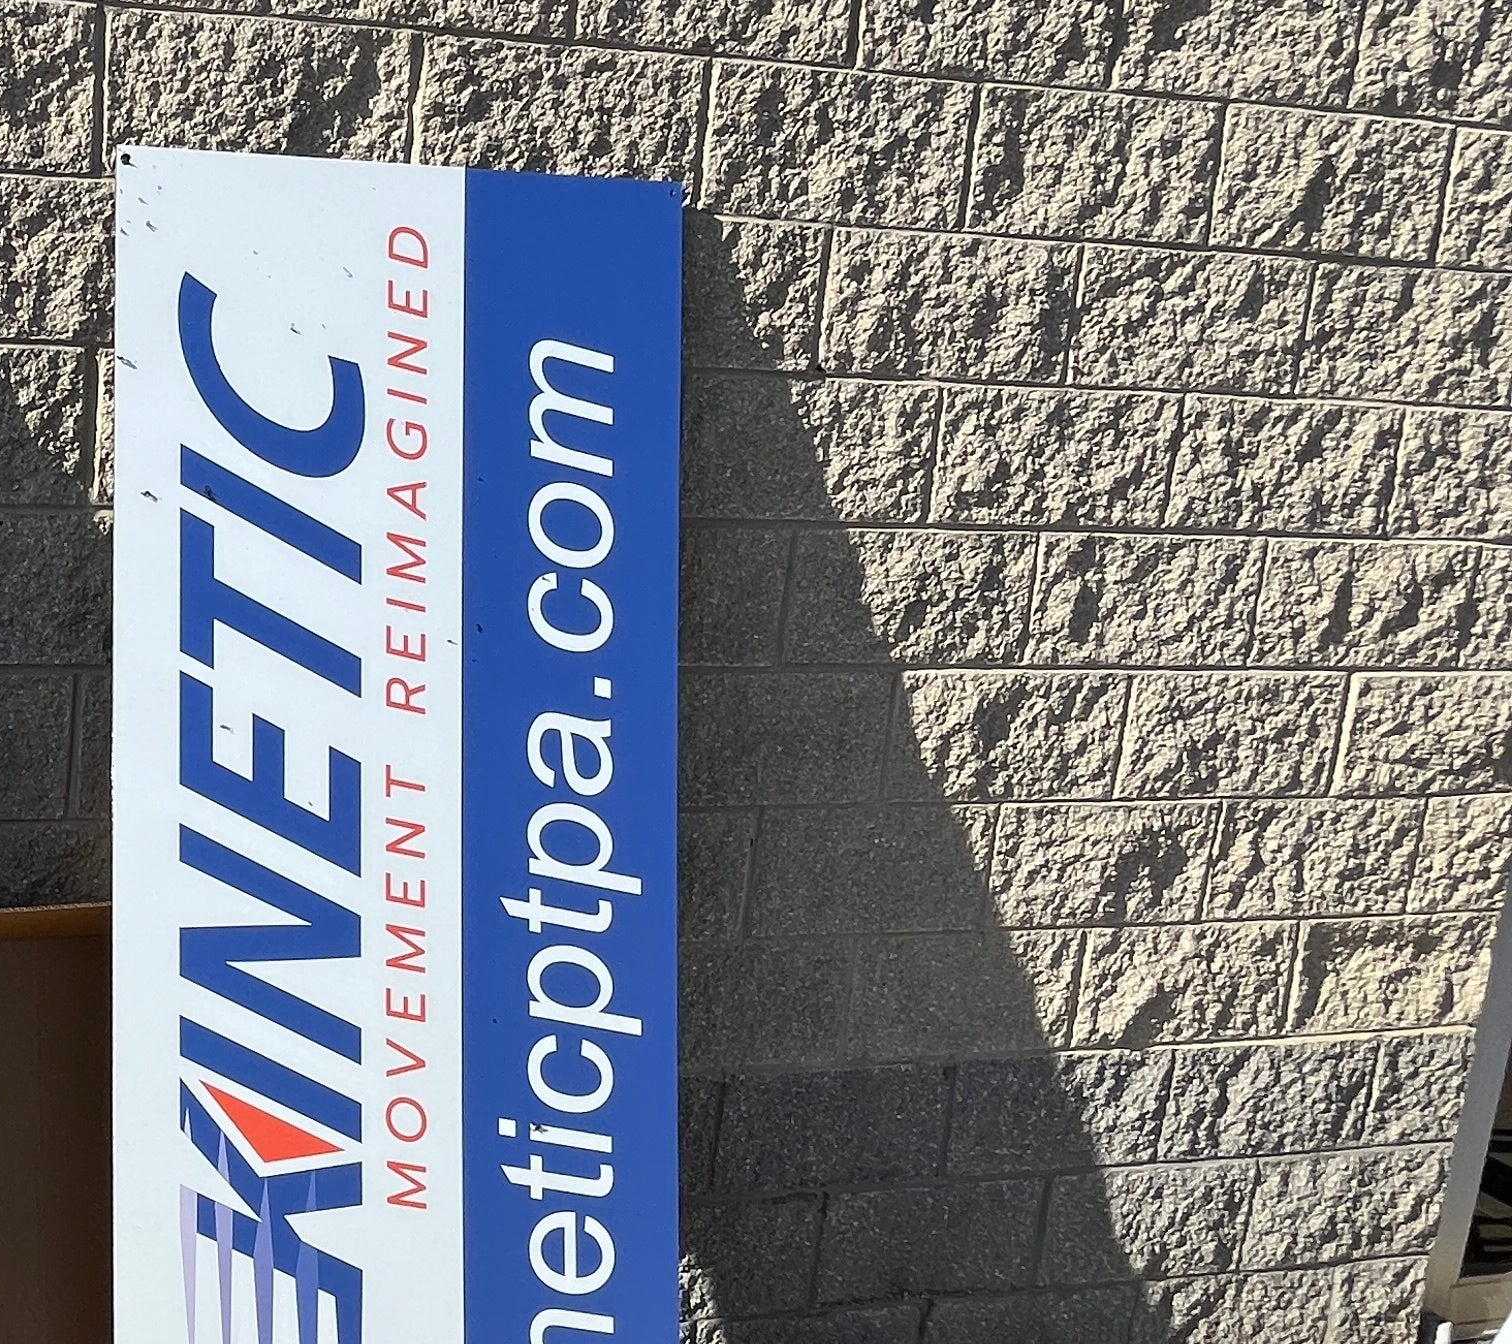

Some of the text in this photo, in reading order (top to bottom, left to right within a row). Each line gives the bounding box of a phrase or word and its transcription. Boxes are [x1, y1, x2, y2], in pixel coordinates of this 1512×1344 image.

[177, 272, 366, 1296] KINETIC
[385, 226, 428, 1209] MOVEMENT REIMAGINED
